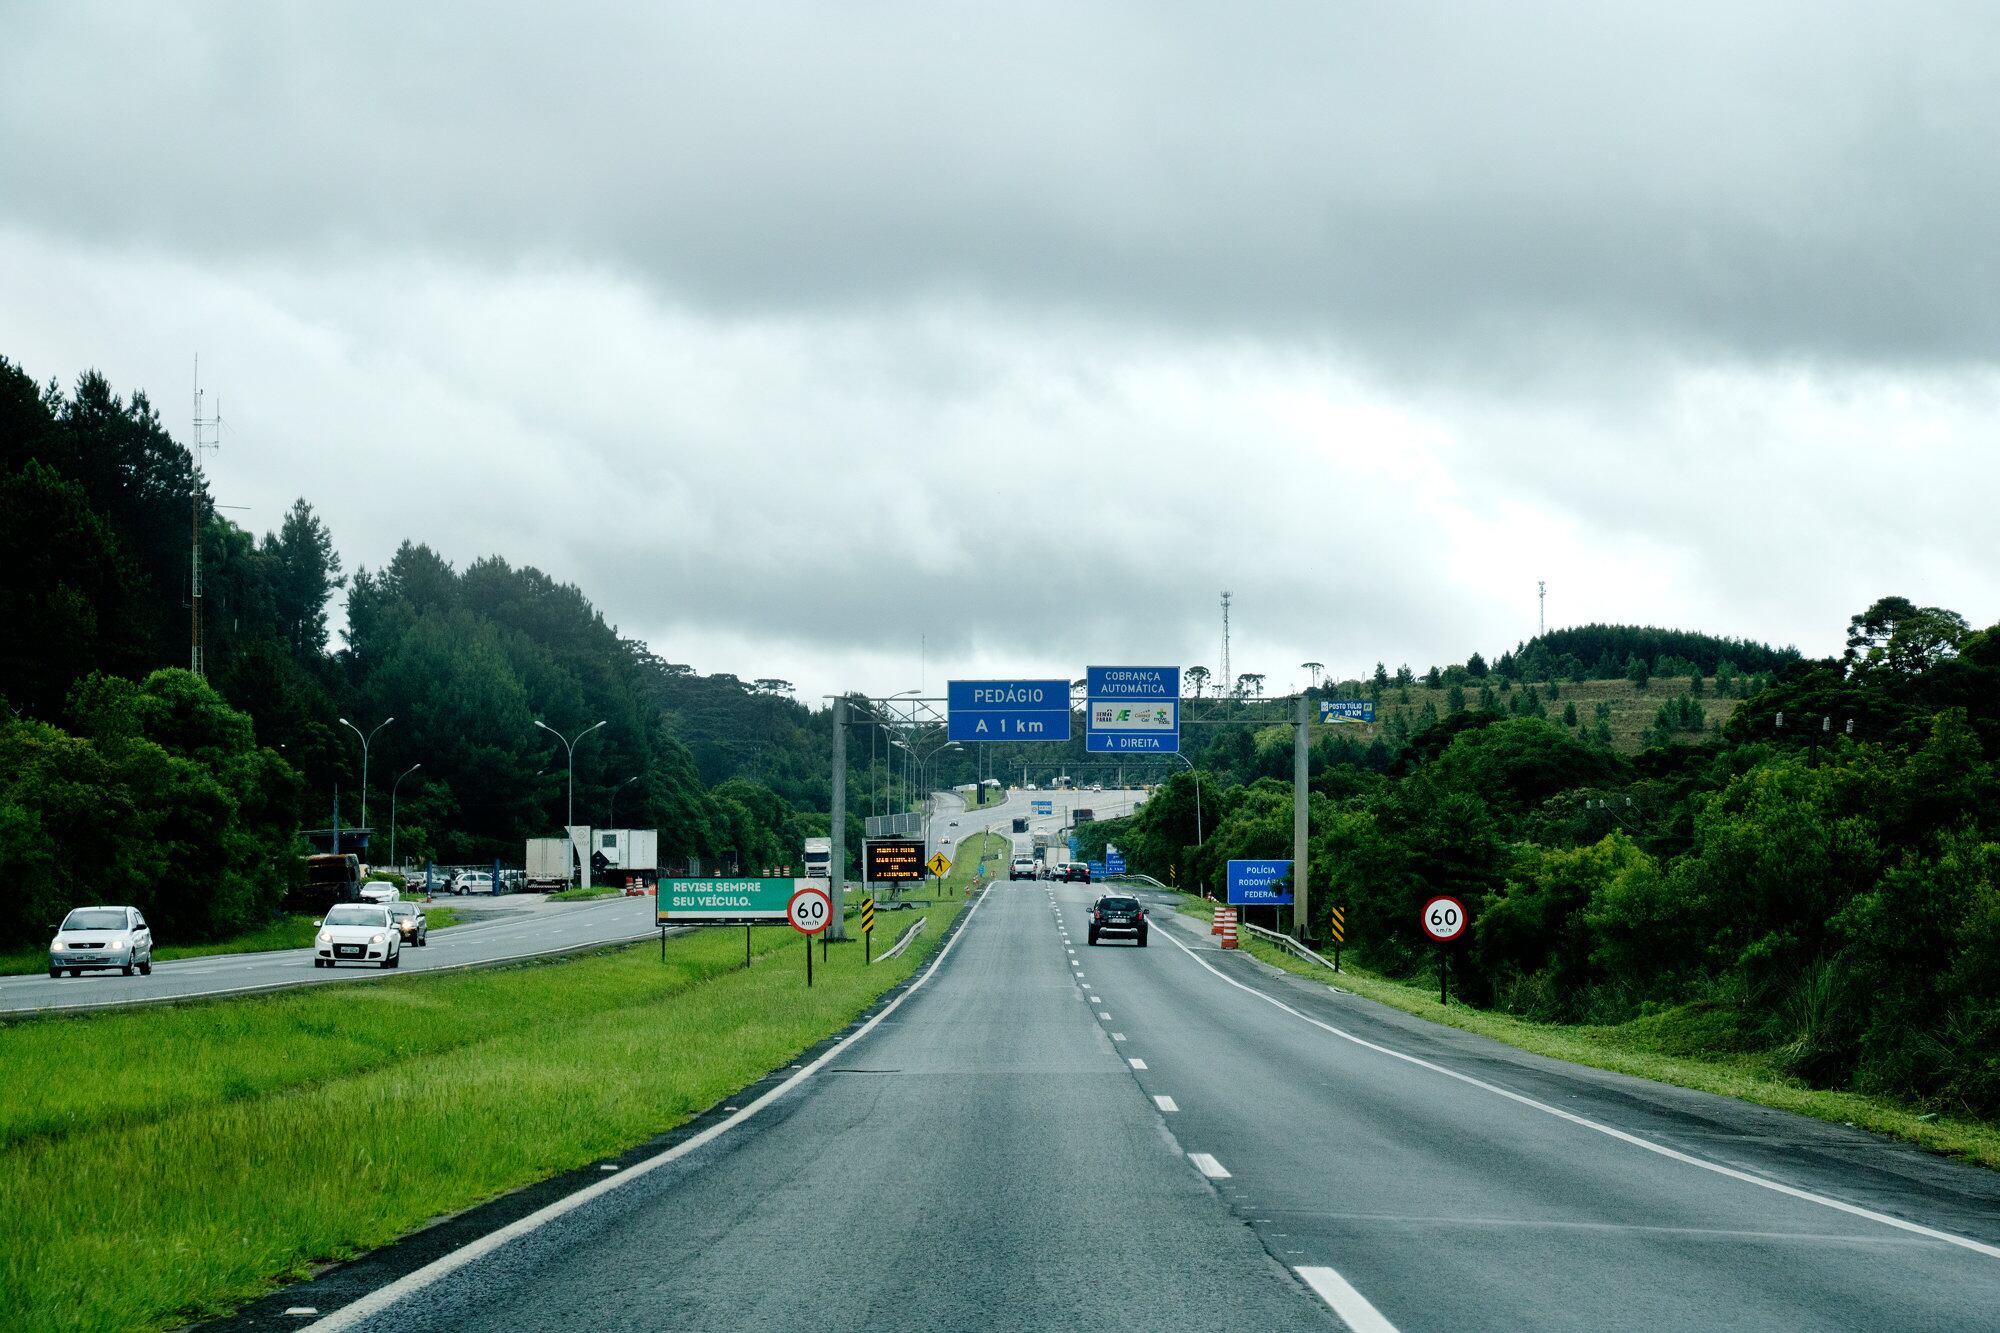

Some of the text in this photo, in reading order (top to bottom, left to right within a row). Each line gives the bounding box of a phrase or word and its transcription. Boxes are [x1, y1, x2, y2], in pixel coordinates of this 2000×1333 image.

[1105, 671, 1161, 683] COBRANÇA
[974, 683, 1044, 703] PEDÁGIO
[1101, 681, 1166, 693] AUTOMÁTICA
[975, 719, 1044, 733] A 1 km
[1106, 736, 1160, 748] À DIREITA
[1246, 864, 1276, 874] POLÍCIA
[673, 882, 761, 892] REVISE SEMPRE
[672, 894, 752, 906] SEU VEÍCULO.
[1244, 890, 1278, 898] FEDERAL
[797, 901, 824, 919] 60
[1431, 908, 1457, 926] 60
